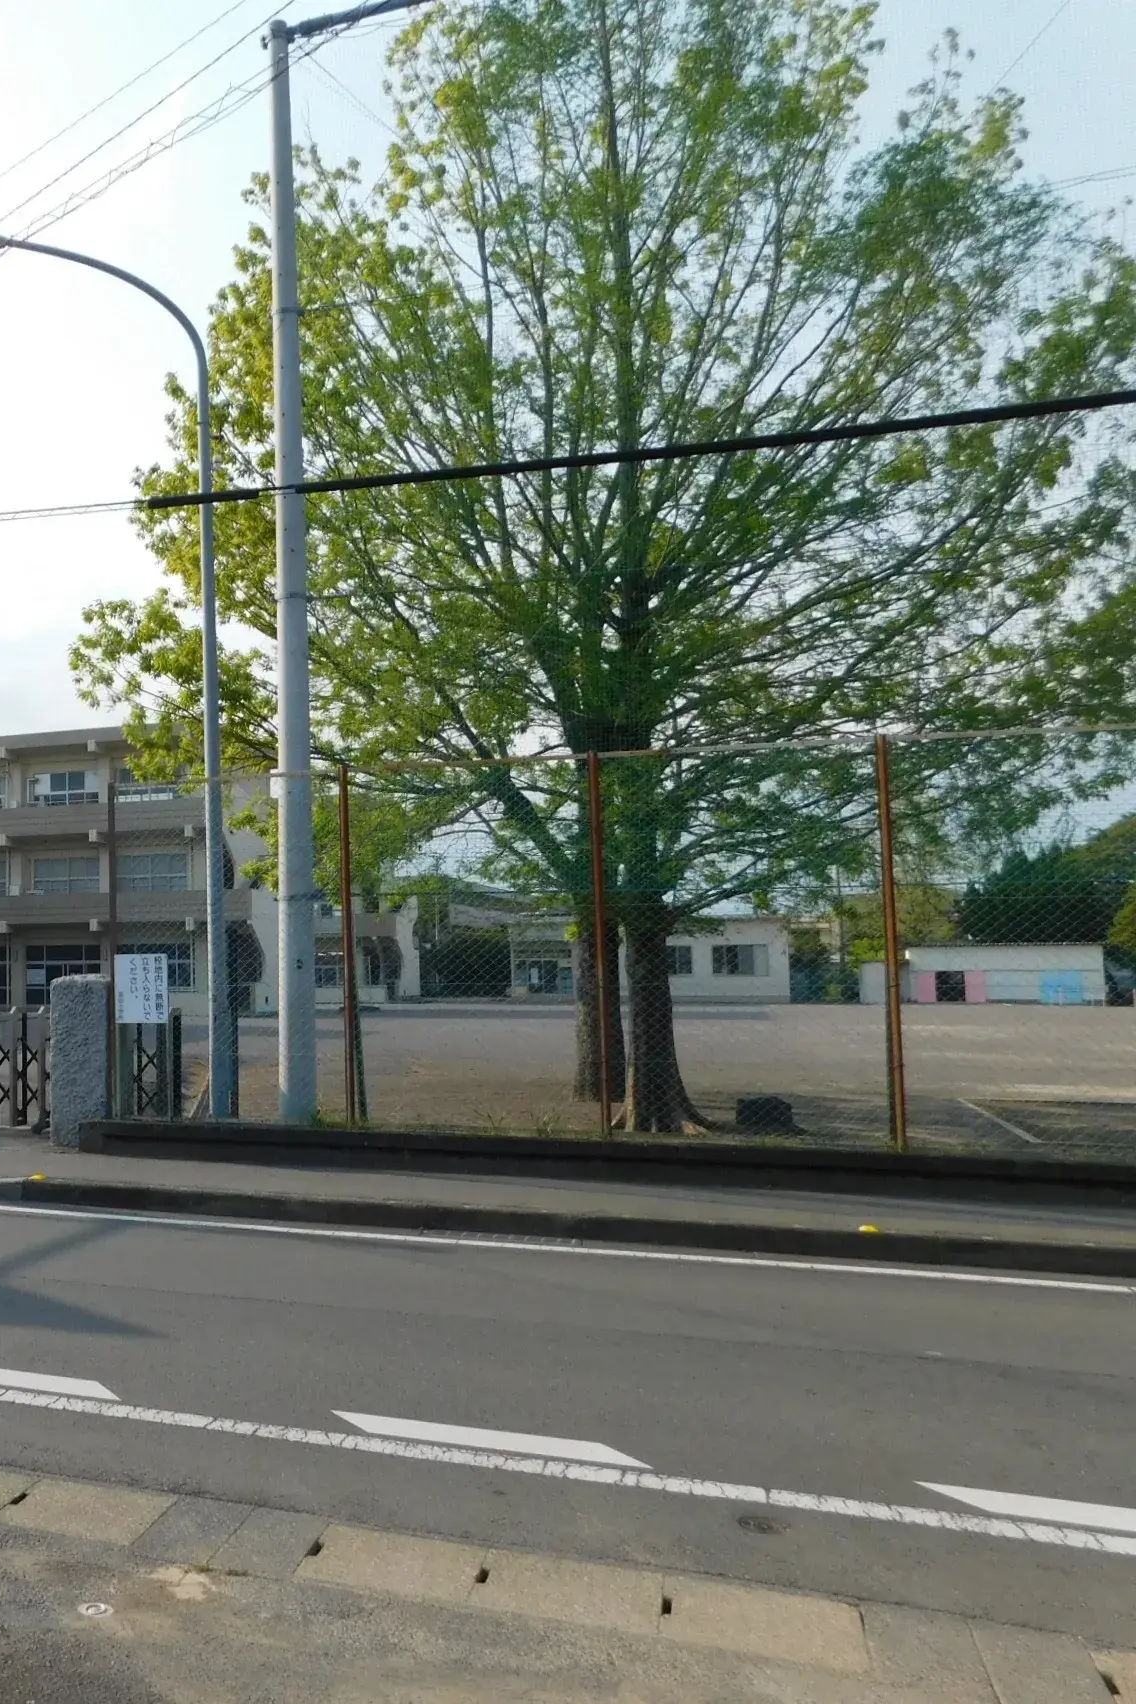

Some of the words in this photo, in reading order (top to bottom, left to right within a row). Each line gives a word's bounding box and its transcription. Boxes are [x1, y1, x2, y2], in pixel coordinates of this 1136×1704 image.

[142, 957, 151, 1020] 立ち入らないで
